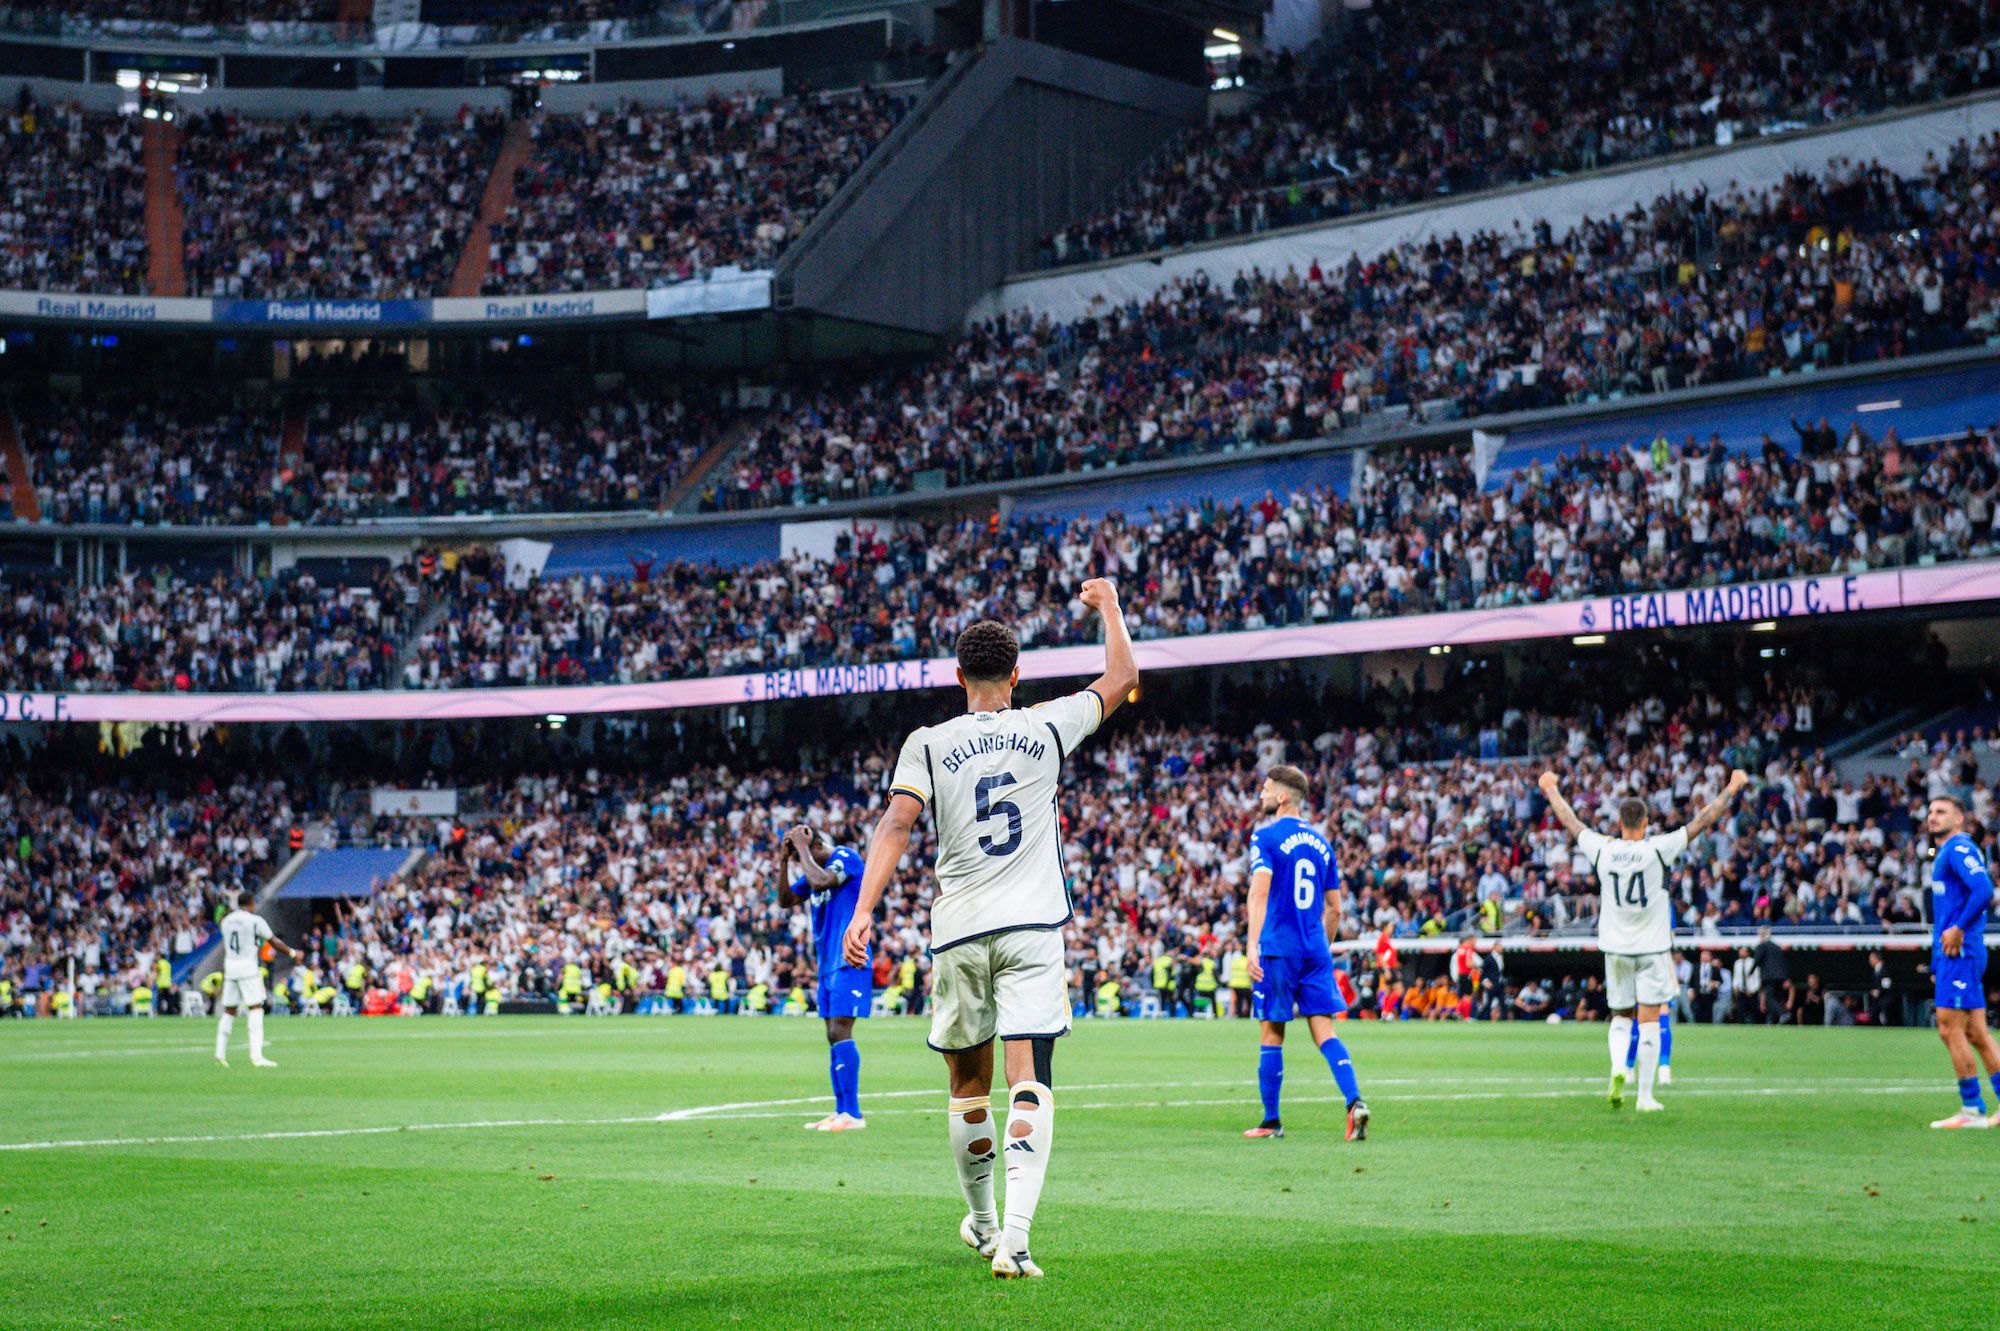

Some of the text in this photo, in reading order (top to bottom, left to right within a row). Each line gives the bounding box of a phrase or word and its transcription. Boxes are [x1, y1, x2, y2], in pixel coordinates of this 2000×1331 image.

[38, 299, 155, 319] Real Madrid
[267, 302, 380, 320] Real Madrid
[486, 300, 594, 318] Real Madrid
[1611, 576, 1863, 630] REAL MADRID C. F.
[765, 659, 934, 700] REAL MADRID C. F.
[20, 692, 42, 720] C.
[55, 693, 71, 720] F.
[942, 733, 1045, 774] BELLINGHAM
[975, 772, 1022, 857] 5
[1294, 858, 1316, 910] 6
[1608, 871, 1648, 908] 14
[230, 930, 240, 954] 4
